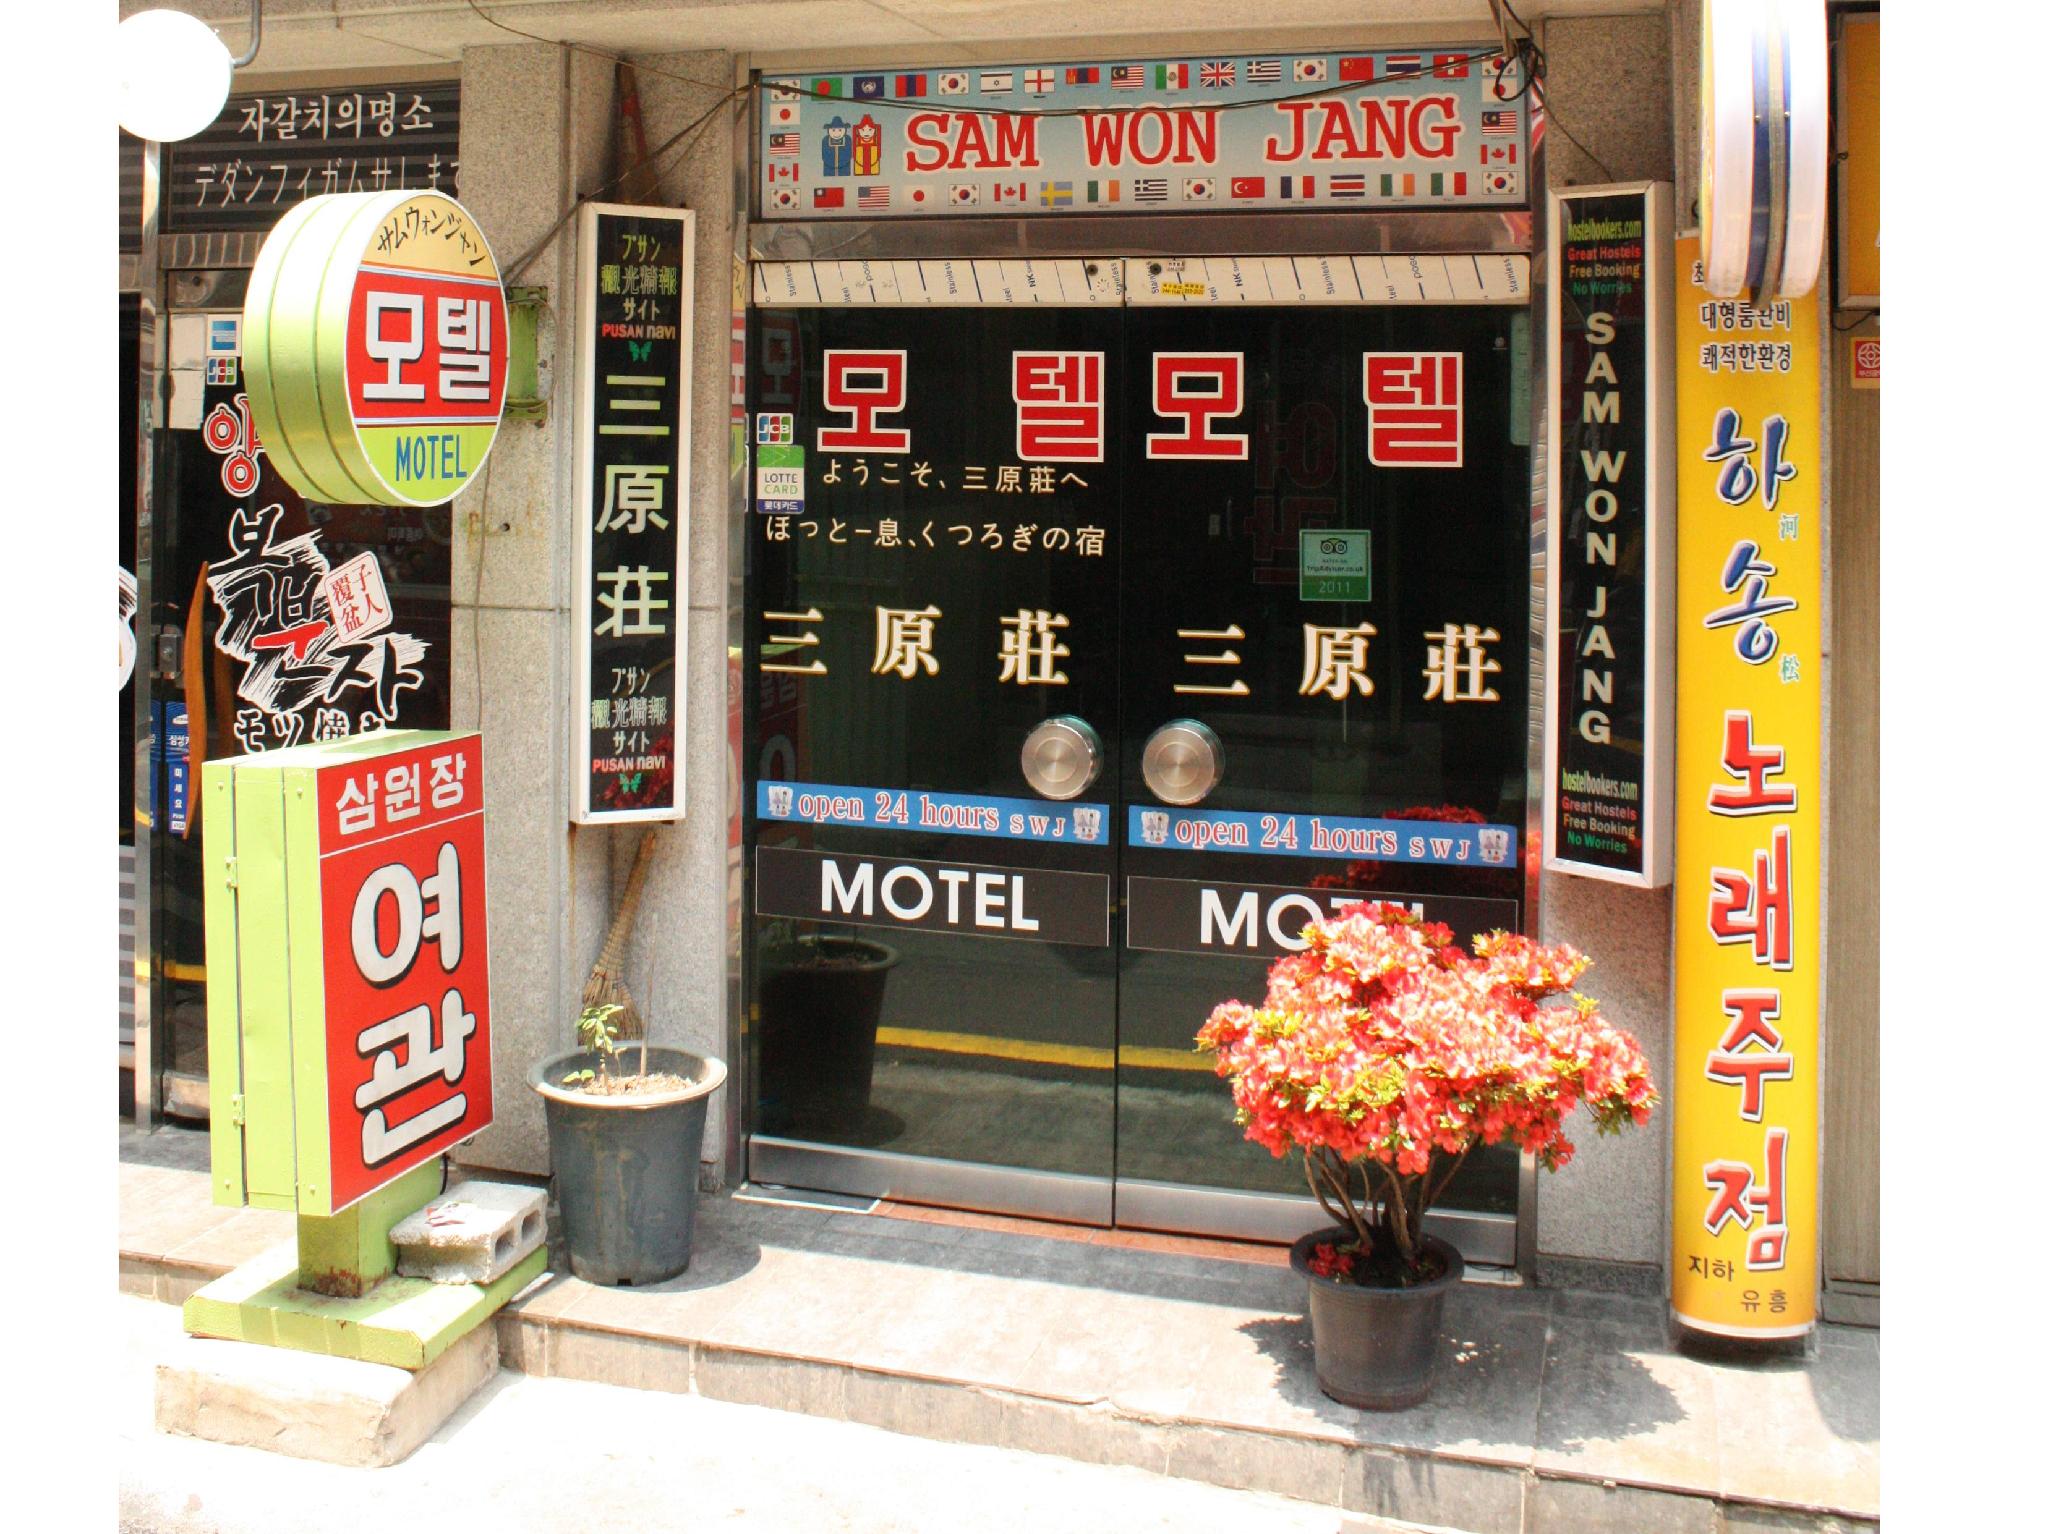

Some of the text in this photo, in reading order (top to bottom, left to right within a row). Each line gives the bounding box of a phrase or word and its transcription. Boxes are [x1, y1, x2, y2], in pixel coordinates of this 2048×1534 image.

[239, 91, 434, 143] 자갈치의명소
[905, 96, 1462, 173] SAM WON JANG
[378, 206, 487, 266] サムウォンジャン
[1567, 245, 1641, 261] Great Hostels
[1569, 262, 1640, 279] Free Booking
[1572, 280, 1632, 295] No Worries
[623, 297, 660, 321] サイト
[602, 323, 643, 338] PUSAN
[362, 290, 491, 403] 모텔
[1701, 342, 1792, 372] 쾌적한환경
[1583, 312, 1620, 424] SAM
[817, 350, 1104, 462] 모텔
[1146, 352, 1463, 467] 모텔
[396, 434, 467, 482] MOTEL
[764, 472, 798, 484] LOTTE
[764, 484, 798, 496] CARD
[1581, 450, 1627, 566] WON
[1319, 581, 1350, 593] 2011
[1579, 586, 1616, 745] JANG
[613, 730, 650, 755] サイト
[592, 757, 634, 774] PUSAN
[335, 751, 467, 836] 삼원장
[1562, 767, 1638, 800] hostelbookers.com
[799, 793, 864, 822] open
[876, 792, 908, 823] 24
[921, 795, 999, 831] hours
[1561, 795, 1638, 820] Great Hostels
[1175, 818, 1248, 848] open
[1261, 816, 1298, 848] 24
[1310, 818, 1397, 856] hours
[1563, 813, 1636, 840] Free Booking
[1567, 830, 1627, 853] No Worries
[821, 859, 1039, 931] MOTEL
[350, 840, 476, 1169] 여관
[1688, 1255, 1735, 1282] 지하
[1741, 1290, 1788, 1314] 유흥
